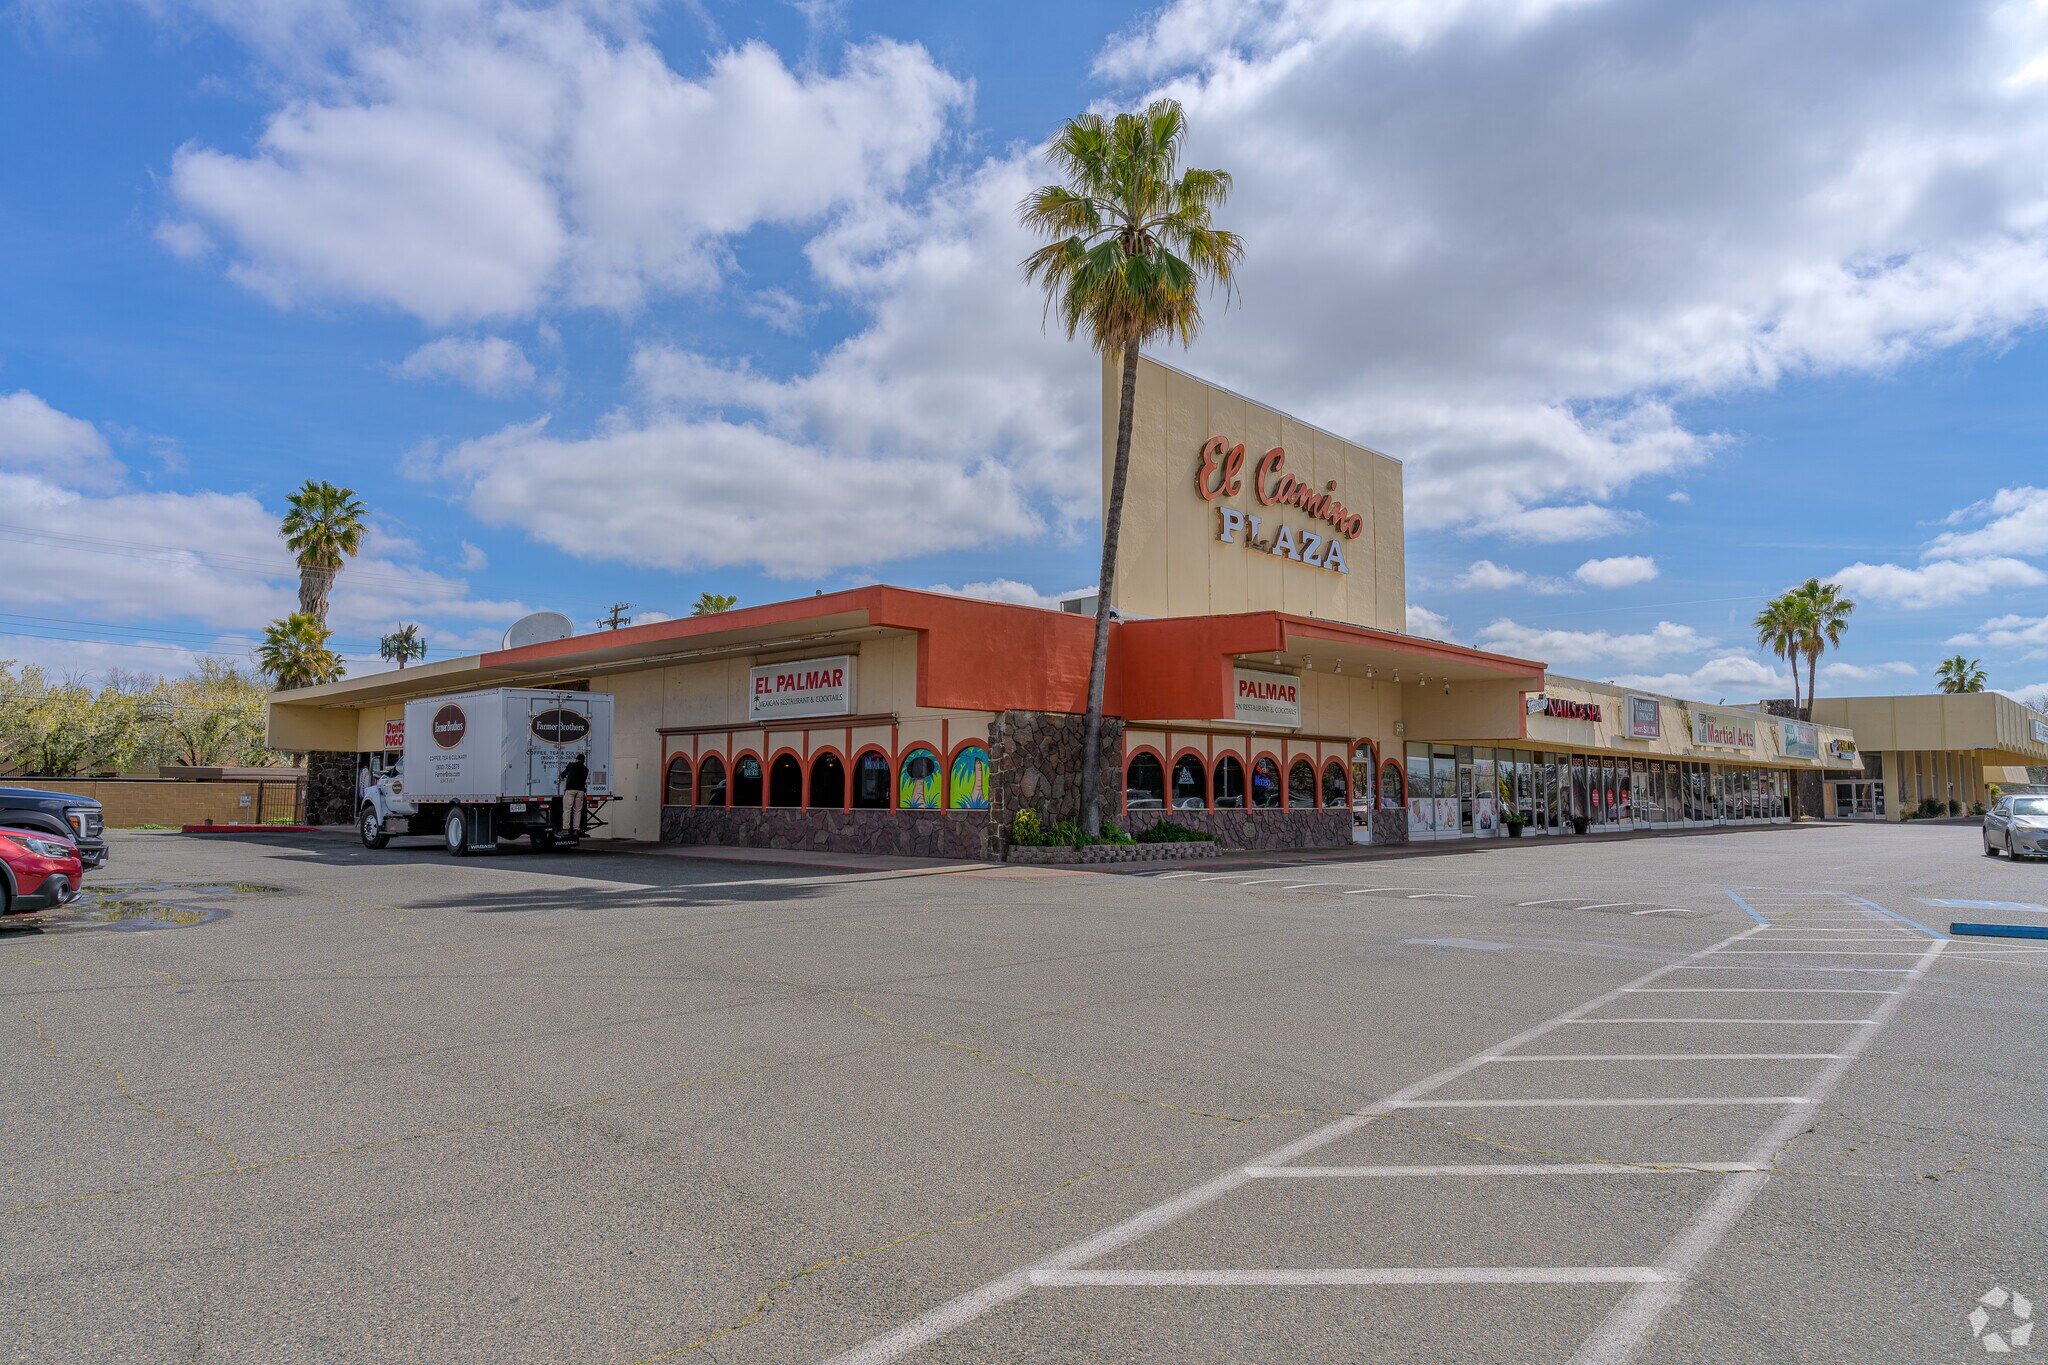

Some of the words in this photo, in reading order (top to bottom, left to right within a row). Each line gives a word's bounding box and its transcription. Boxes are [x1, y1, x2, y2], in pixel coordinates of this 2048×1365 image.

[1195, 435, 1245, 500] El
[1255, 447, 1363, 540] Camino
[1216, 506, 1350, 574] PLAZA
[755, 677, 772, 694] EL
[776, 668, 843, 692] PALMAR
[1239, 679, 1296, 702] PALMAR
[780, 696, 809, 706] RESTAURANT
[815, 693, 843, 703] COCKTAILS
[1243, 703, 1270, 712] RESTAURANT
[1275, 707, 1297, 715] COCKTAILS
[1548, 699, 1577, 719] NAILS
[1578, 703, 1585, 719] &
[1586, 703, 1602, 722] SPA
[434, 721, 447, 732] Farmer
[447, 720, 464, 732] Brothers
[536, 721, 558, 731] Farmer
[560, 722, 585, 731] Brothers
[1707, 723, 1736, 744] Martial
[1738, 728, 1754, 747] Arts
